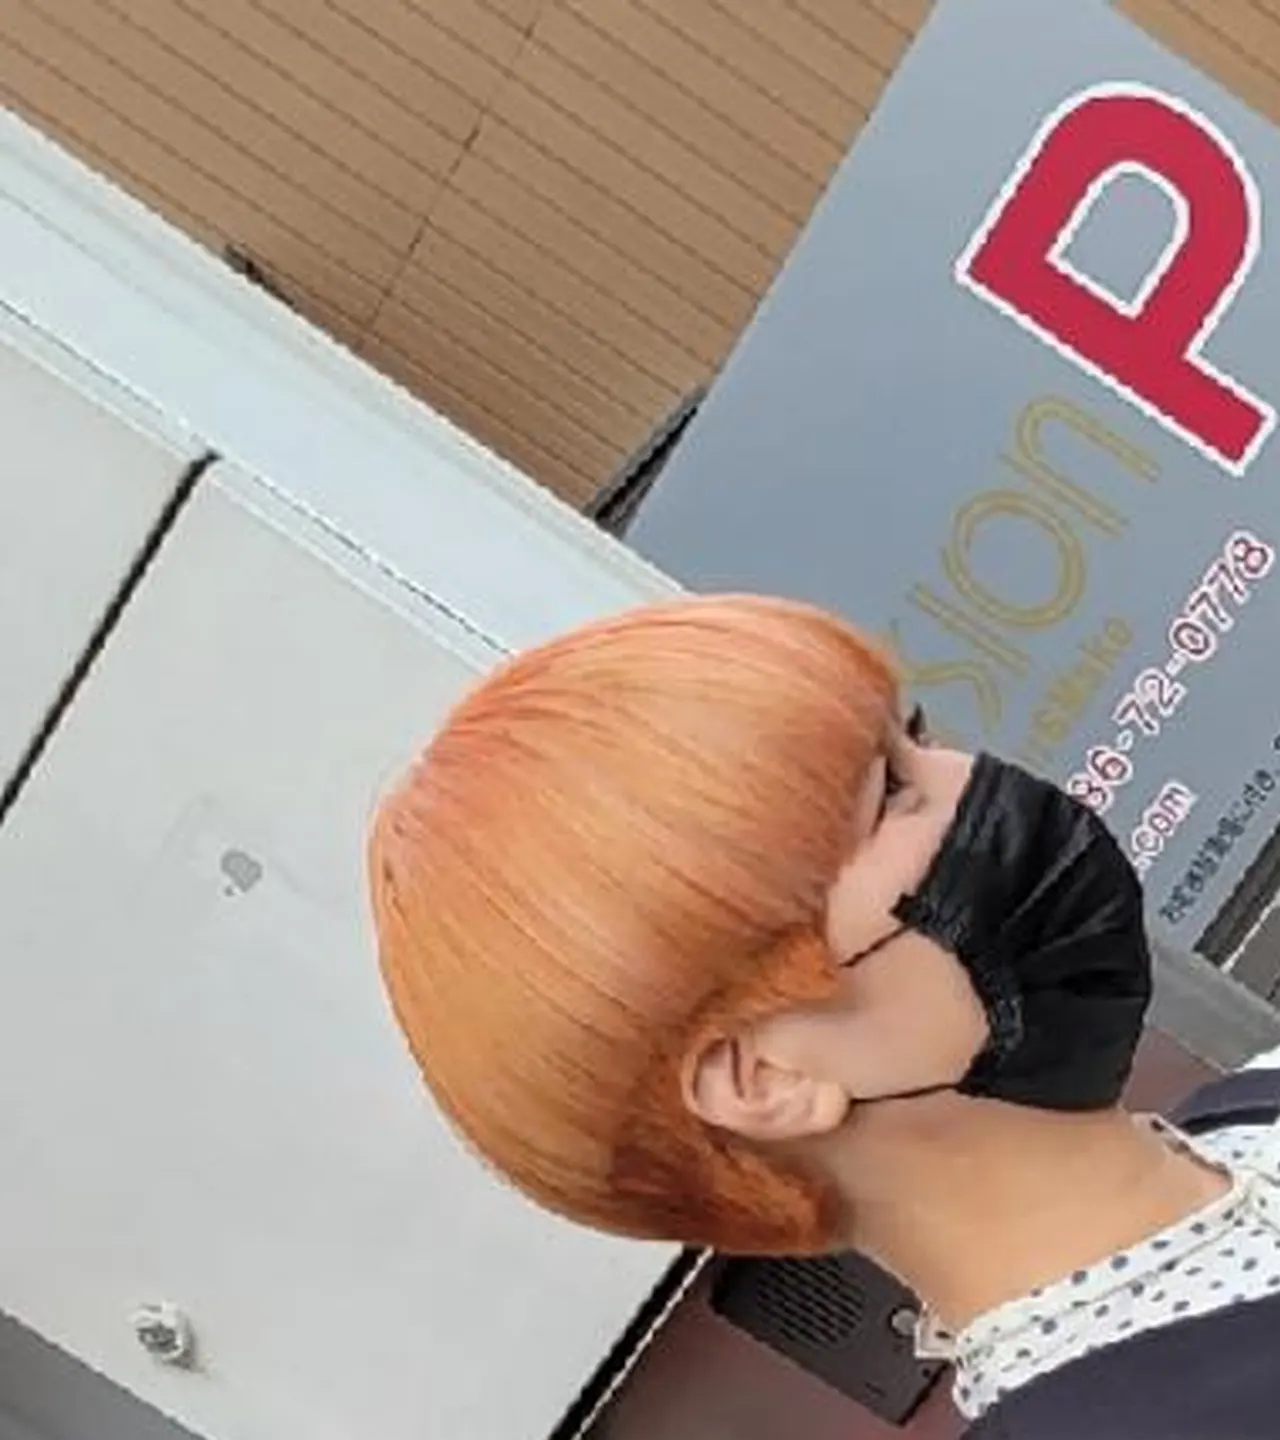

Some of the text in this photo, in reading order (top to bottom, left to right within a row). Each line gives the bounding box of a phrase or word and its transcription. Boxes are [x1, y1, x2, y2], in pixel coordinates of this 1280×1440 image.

[955, 81, 1279, 477] P
[893, 395, 1161, 745] sion
[1067, 529, 1276, 815] 86-72-0778
[1131, 780, 1197, 877] .com
